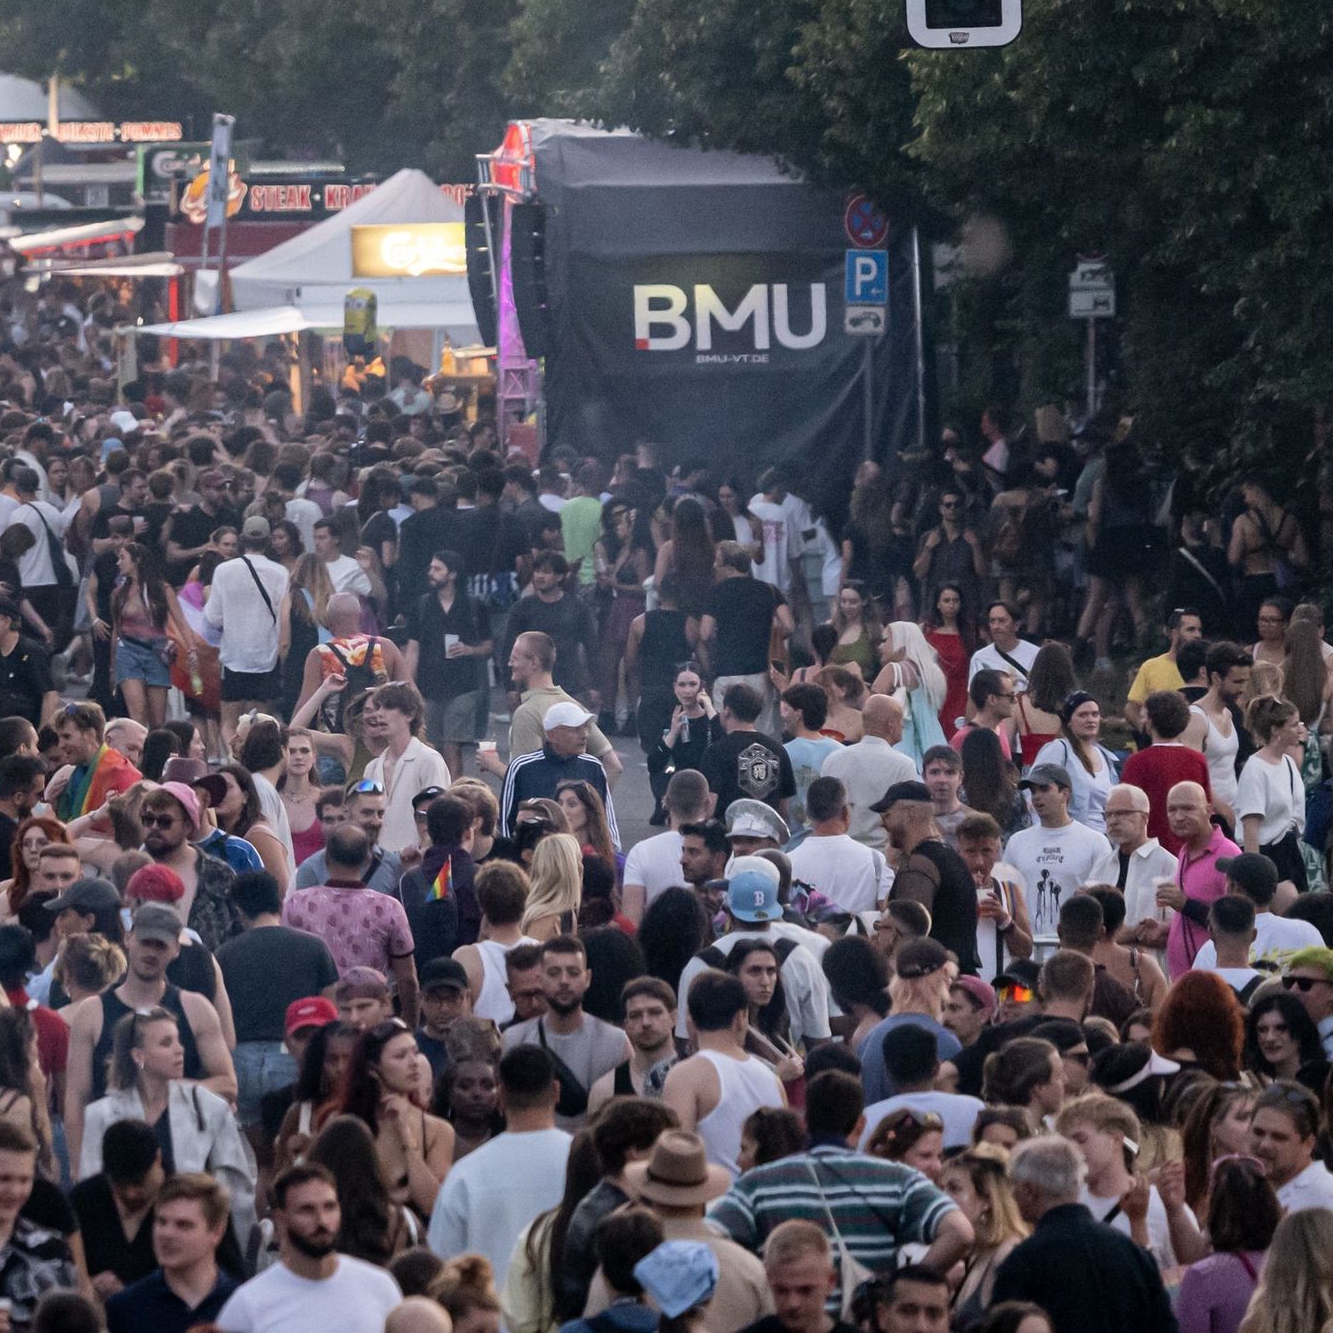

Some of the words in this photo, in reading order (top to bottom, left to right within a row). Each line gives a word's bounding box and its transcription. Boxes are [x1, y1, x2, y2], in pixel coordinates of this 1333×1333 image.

[250, 184, 312, 212] STEAK
[855, 256, 878, 296] P
[634, 283, 827, 351] BMU
